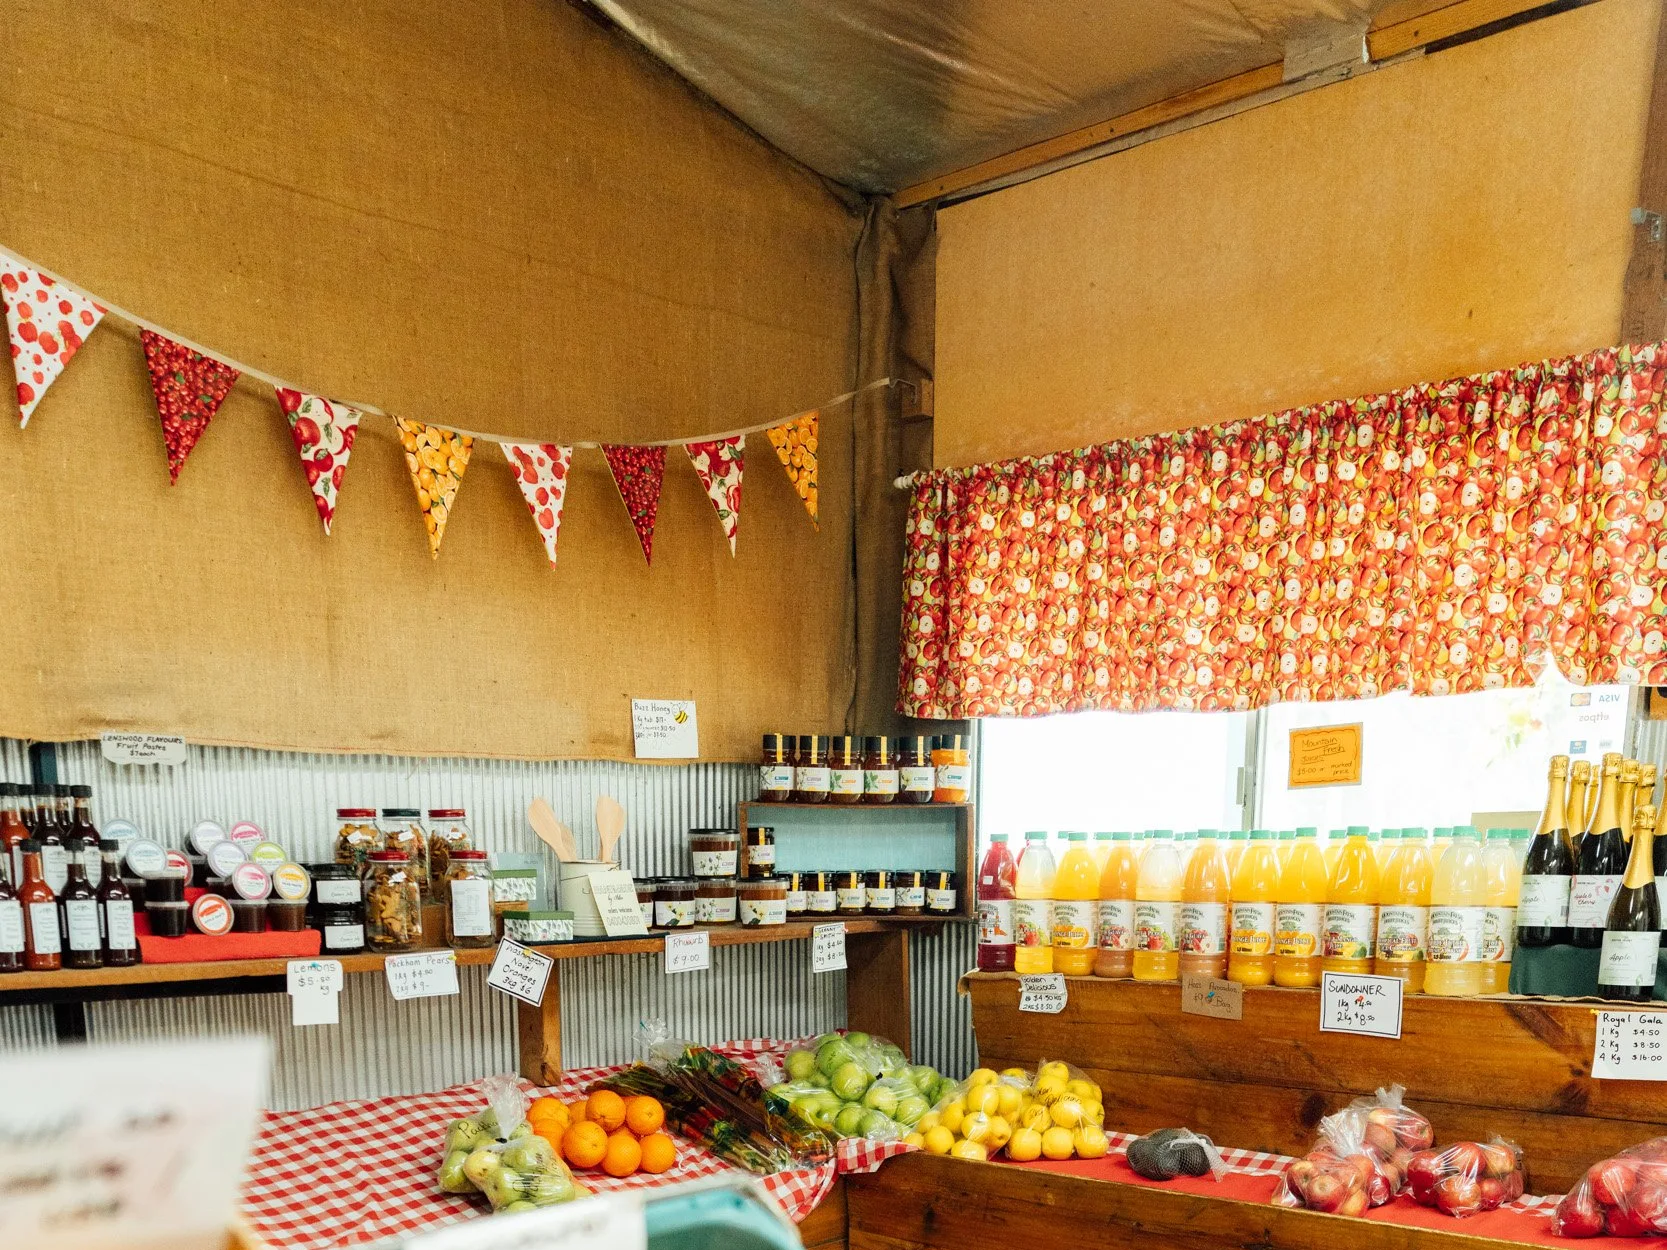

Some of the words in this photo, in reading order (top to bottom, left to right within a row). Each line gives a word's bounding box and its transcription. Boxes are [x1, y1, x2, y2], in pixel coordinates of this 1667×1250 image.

[651, 702, 670, 714] Honey
[1608, 952, 1632, 962] Apple
[502, 964, 536, 986] Oranges
[1603, 1012, 1631, 1028] Royal
[1639, 1014, 1664, 1024] Gala
[1632, 1054, 1663, 1062] $16.00
